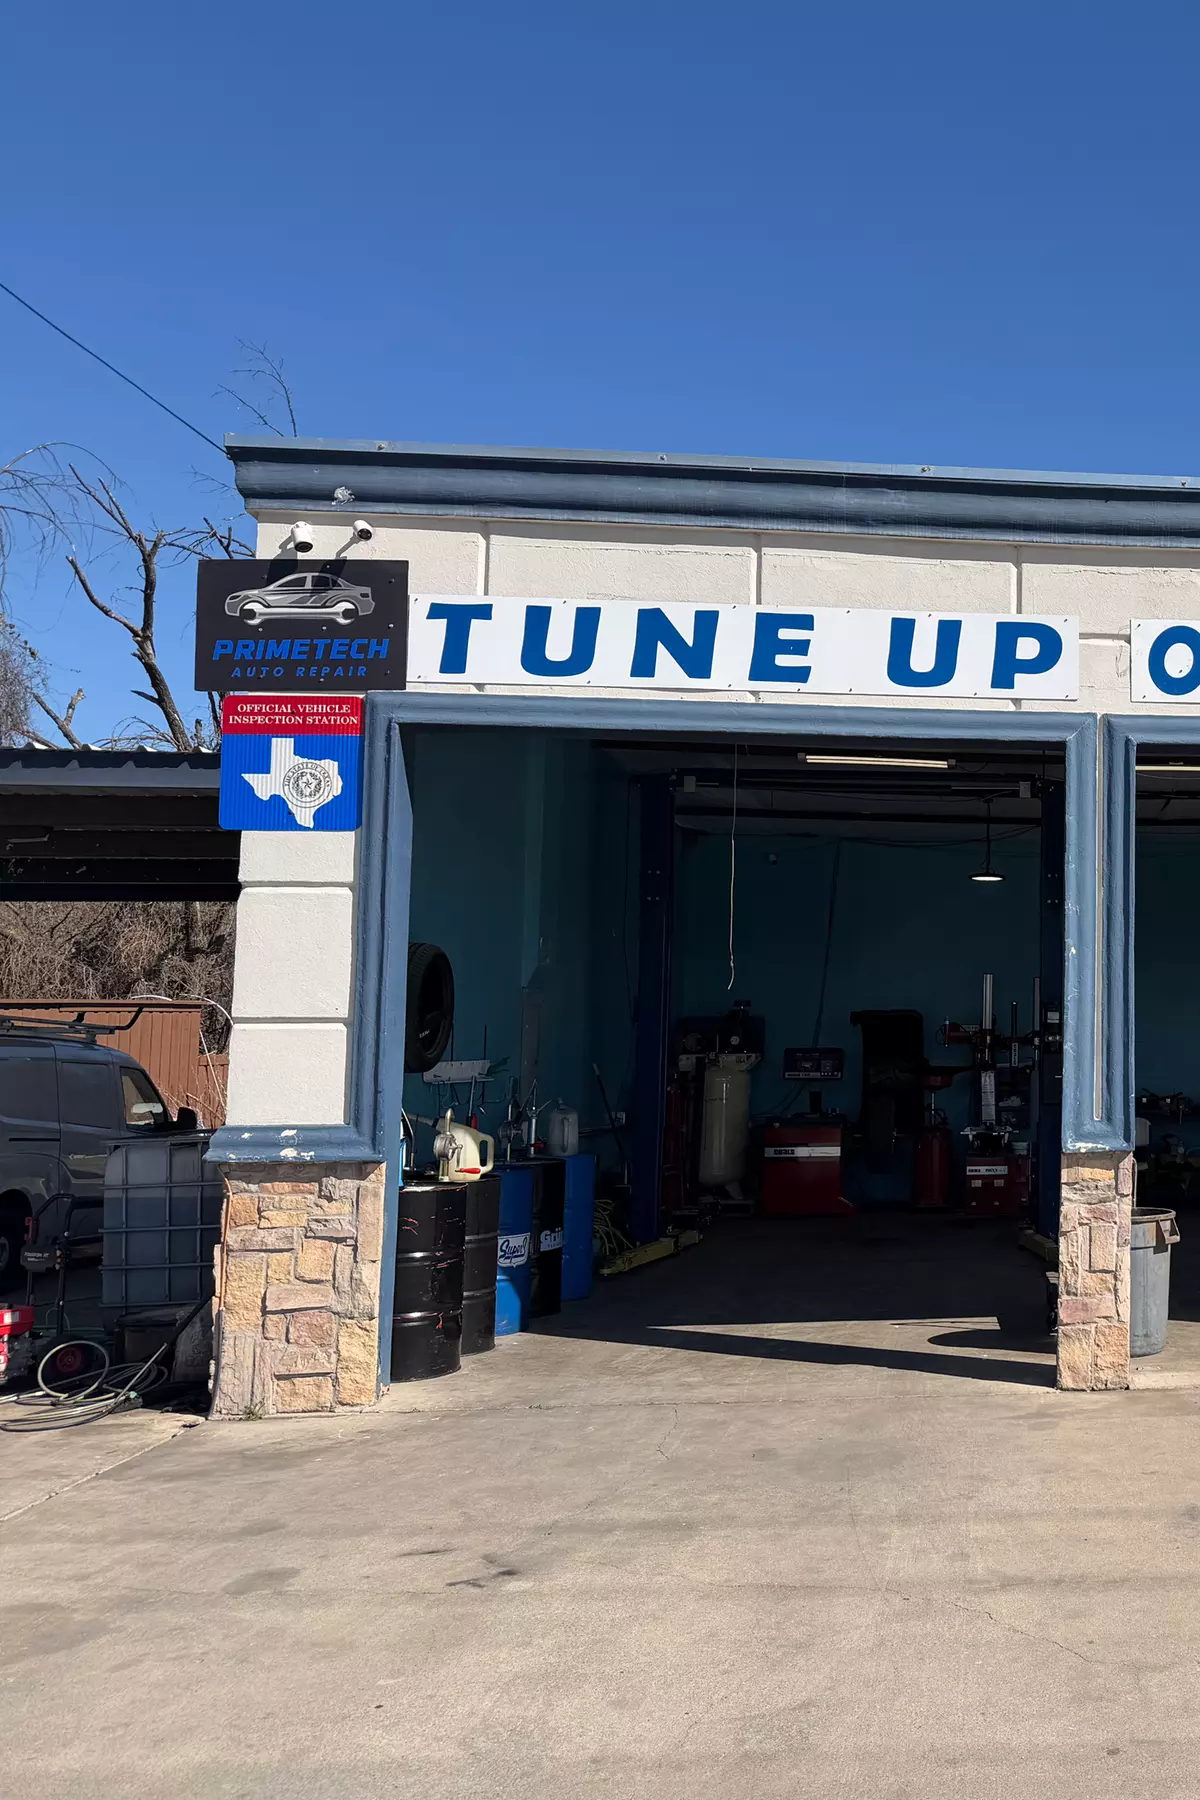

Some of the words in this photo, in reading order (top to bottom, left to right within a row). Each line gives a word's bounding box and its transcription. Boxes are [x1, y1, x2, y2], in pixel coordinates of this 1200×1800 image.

[212, 638, 390, 661] PRIMETECH
[427, 603, 815, 687] TUNE
[887, 617, 1063, 690] UP
[231, 666, 285, 678] AUTO
[295, 665, 367, 678] REPAIR
[237, 703, 292, 713] OFFICIAL
[297, 704, 351, 713] VEHICLE
[228, 715, 303, 725] INSPECTION
[306, 716, 359, 725] STATION
